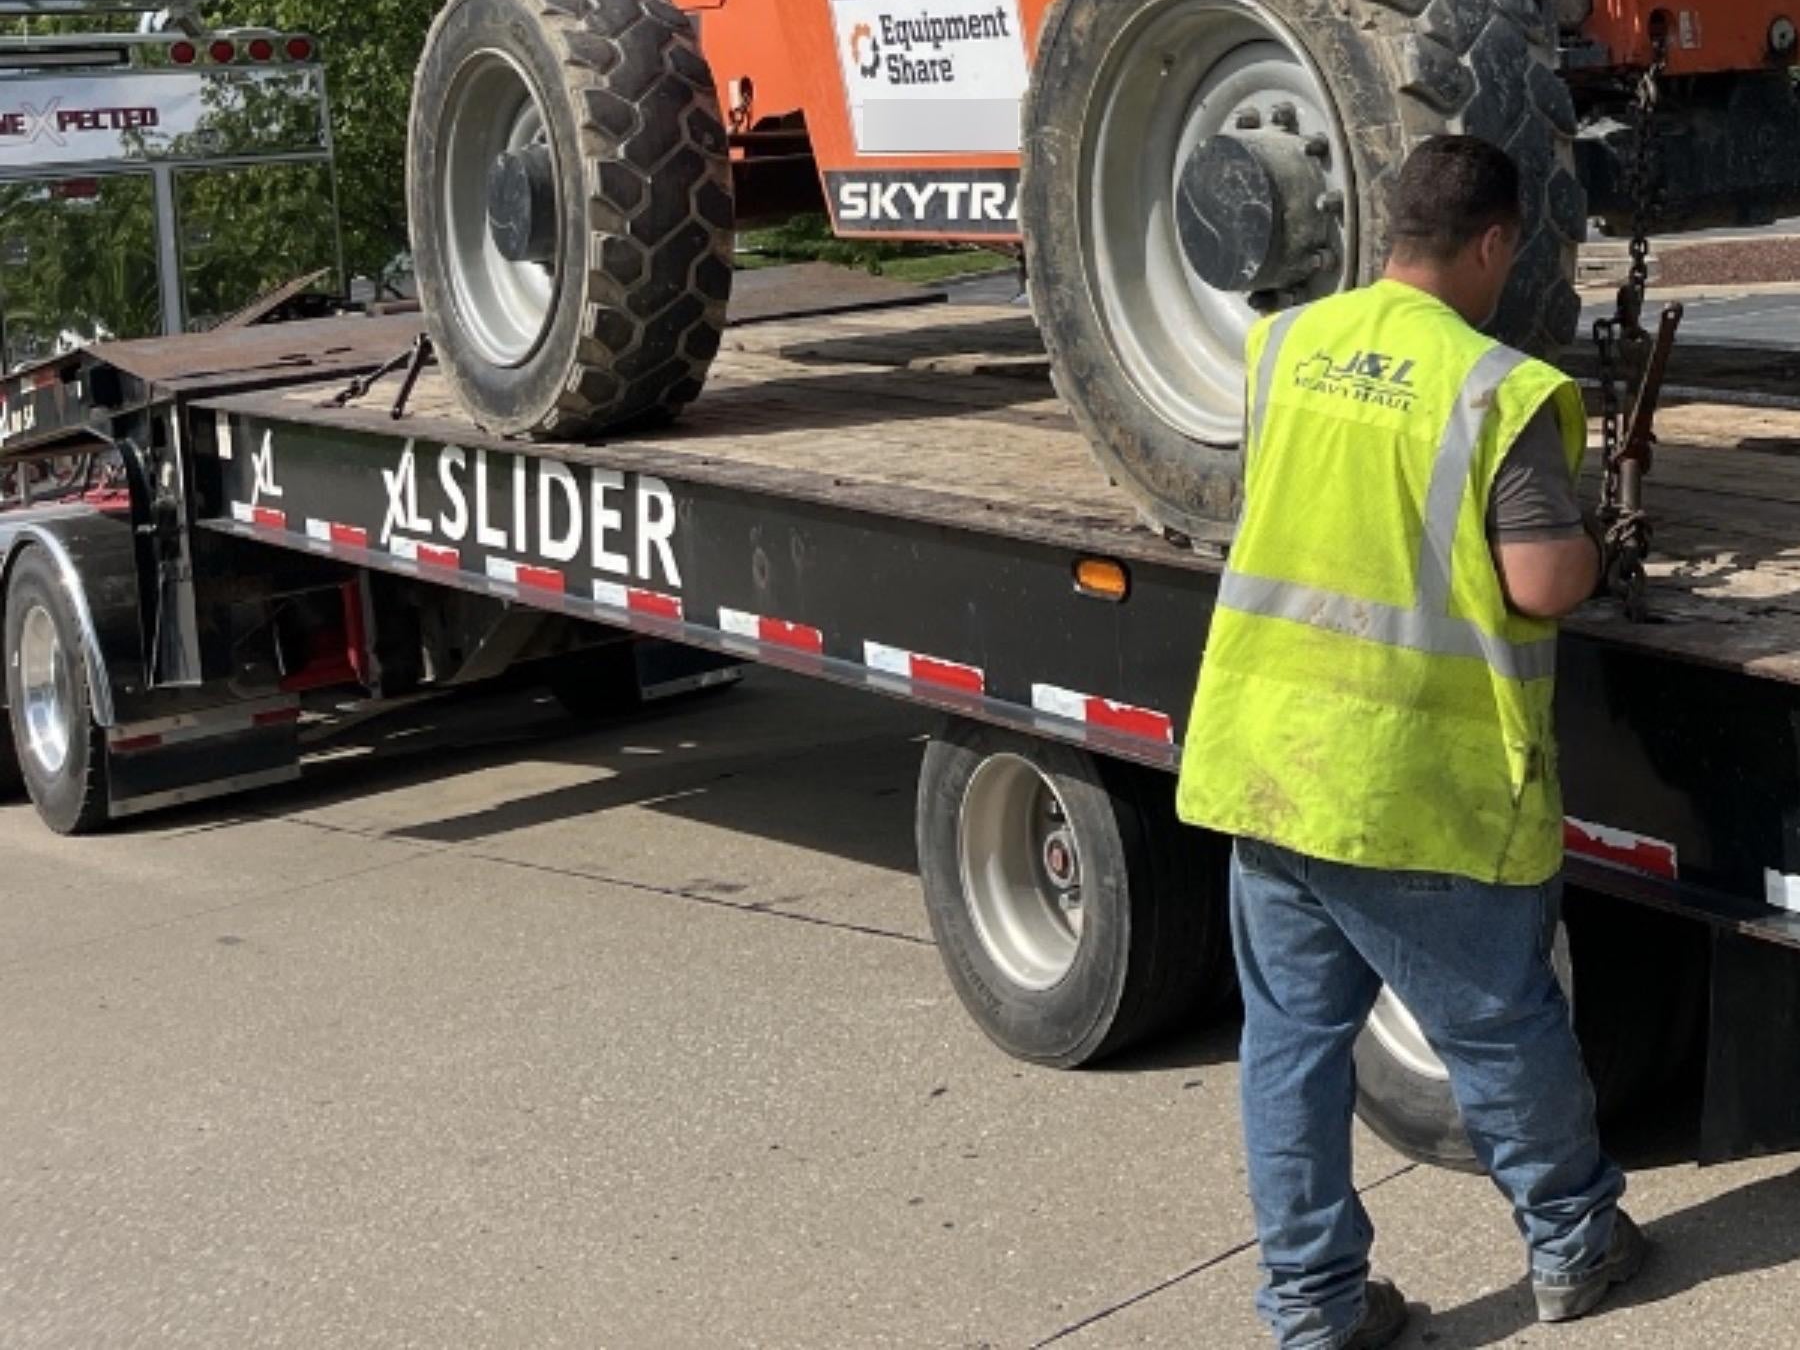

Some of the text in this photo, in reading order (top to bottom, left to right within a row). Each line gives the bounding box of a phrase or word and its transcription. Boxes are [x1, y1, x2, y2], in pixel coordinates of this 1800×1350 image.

[878, 6, 1011, 50] Equipment
[886, 51, 955, 85] Share
[436, 442, 684, 588] SLIDER
